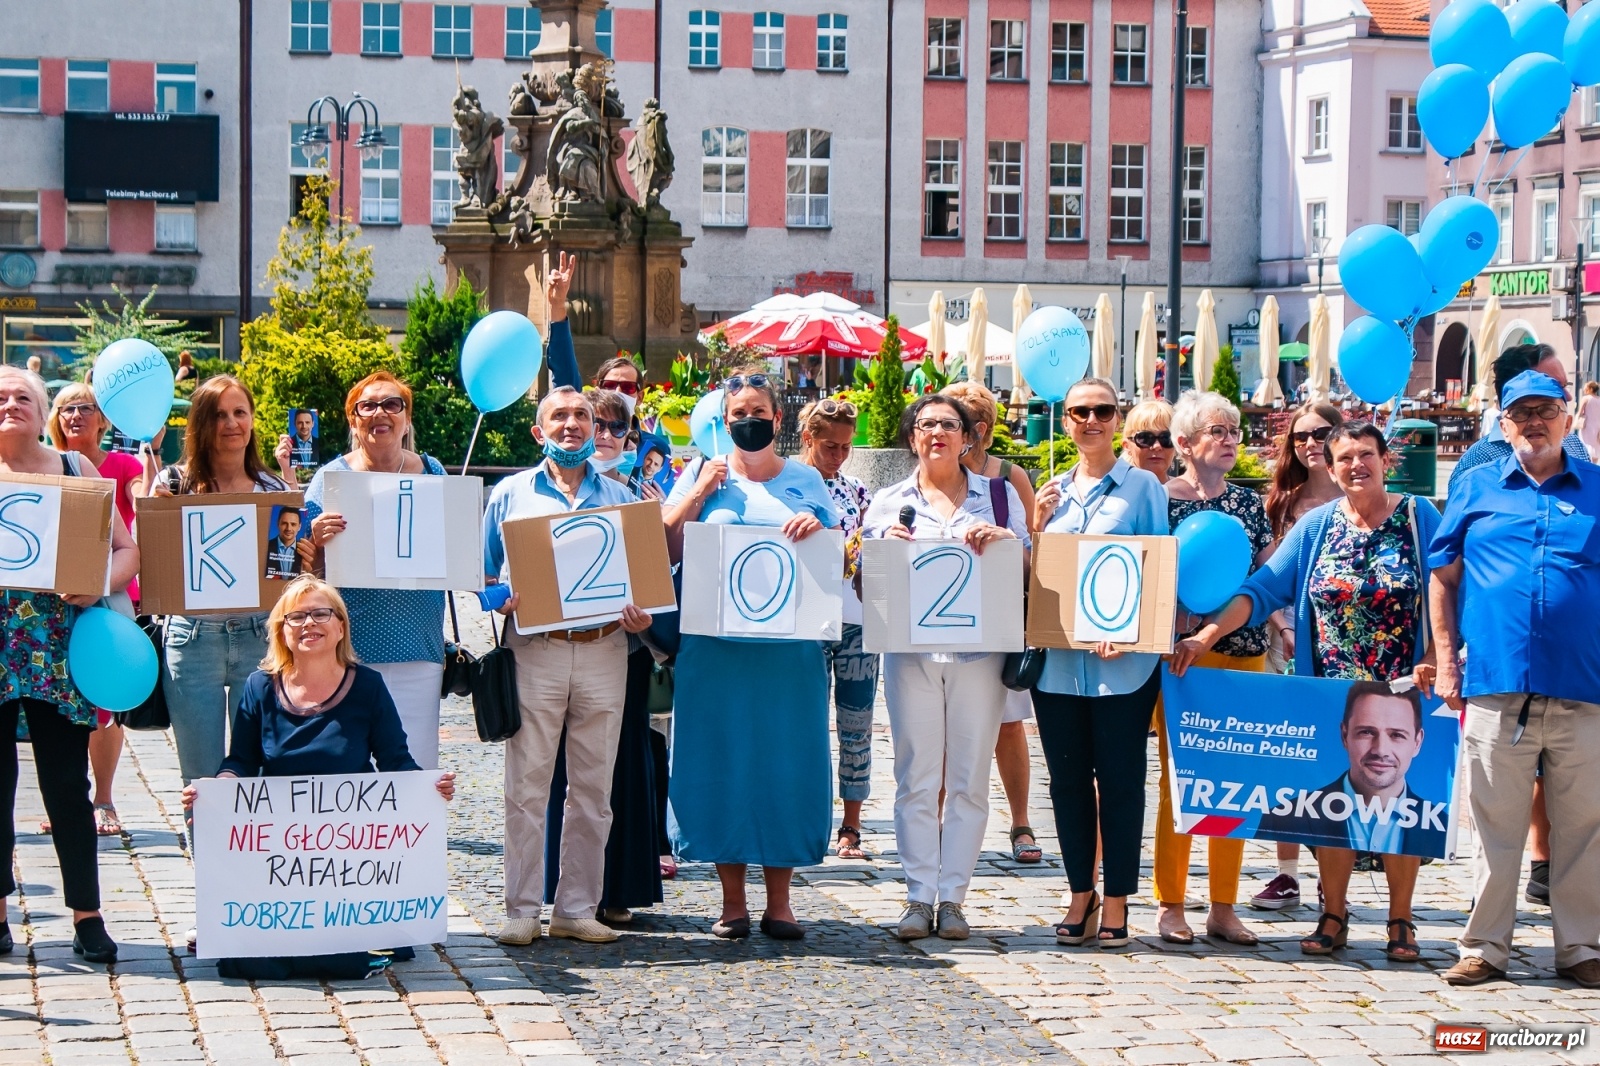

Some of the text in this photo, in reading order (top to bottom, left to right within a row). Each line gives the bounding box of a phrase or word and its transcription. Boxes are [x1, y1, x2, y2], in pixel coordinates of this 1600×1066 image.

[106, 190, 179, 200] Telebimy-Raciborz.pl
[1490, 270, 1550, 296] KANTOR
[0, 492, 43, 571] S
[188, 511, 246, 592] K
[552, 514, 626, 602] 2
[729, 540, 796, 623] 0
[912, 546, 976, 627] 2
[1080, 544, 1141, 632] 0
[1179, 711, 1316, 737] Silny Prezydent
[1179, 732, 1318, 758] Wspólna Polska
[234, 779, 273, 814] NA
[229, 819, 430, 852] NIE GŁOSUJEMY
[266, 854, 404, 887] RAFAŁOWI
[221, 896, 445, 929] DOBRZE WINSZUJEMY
